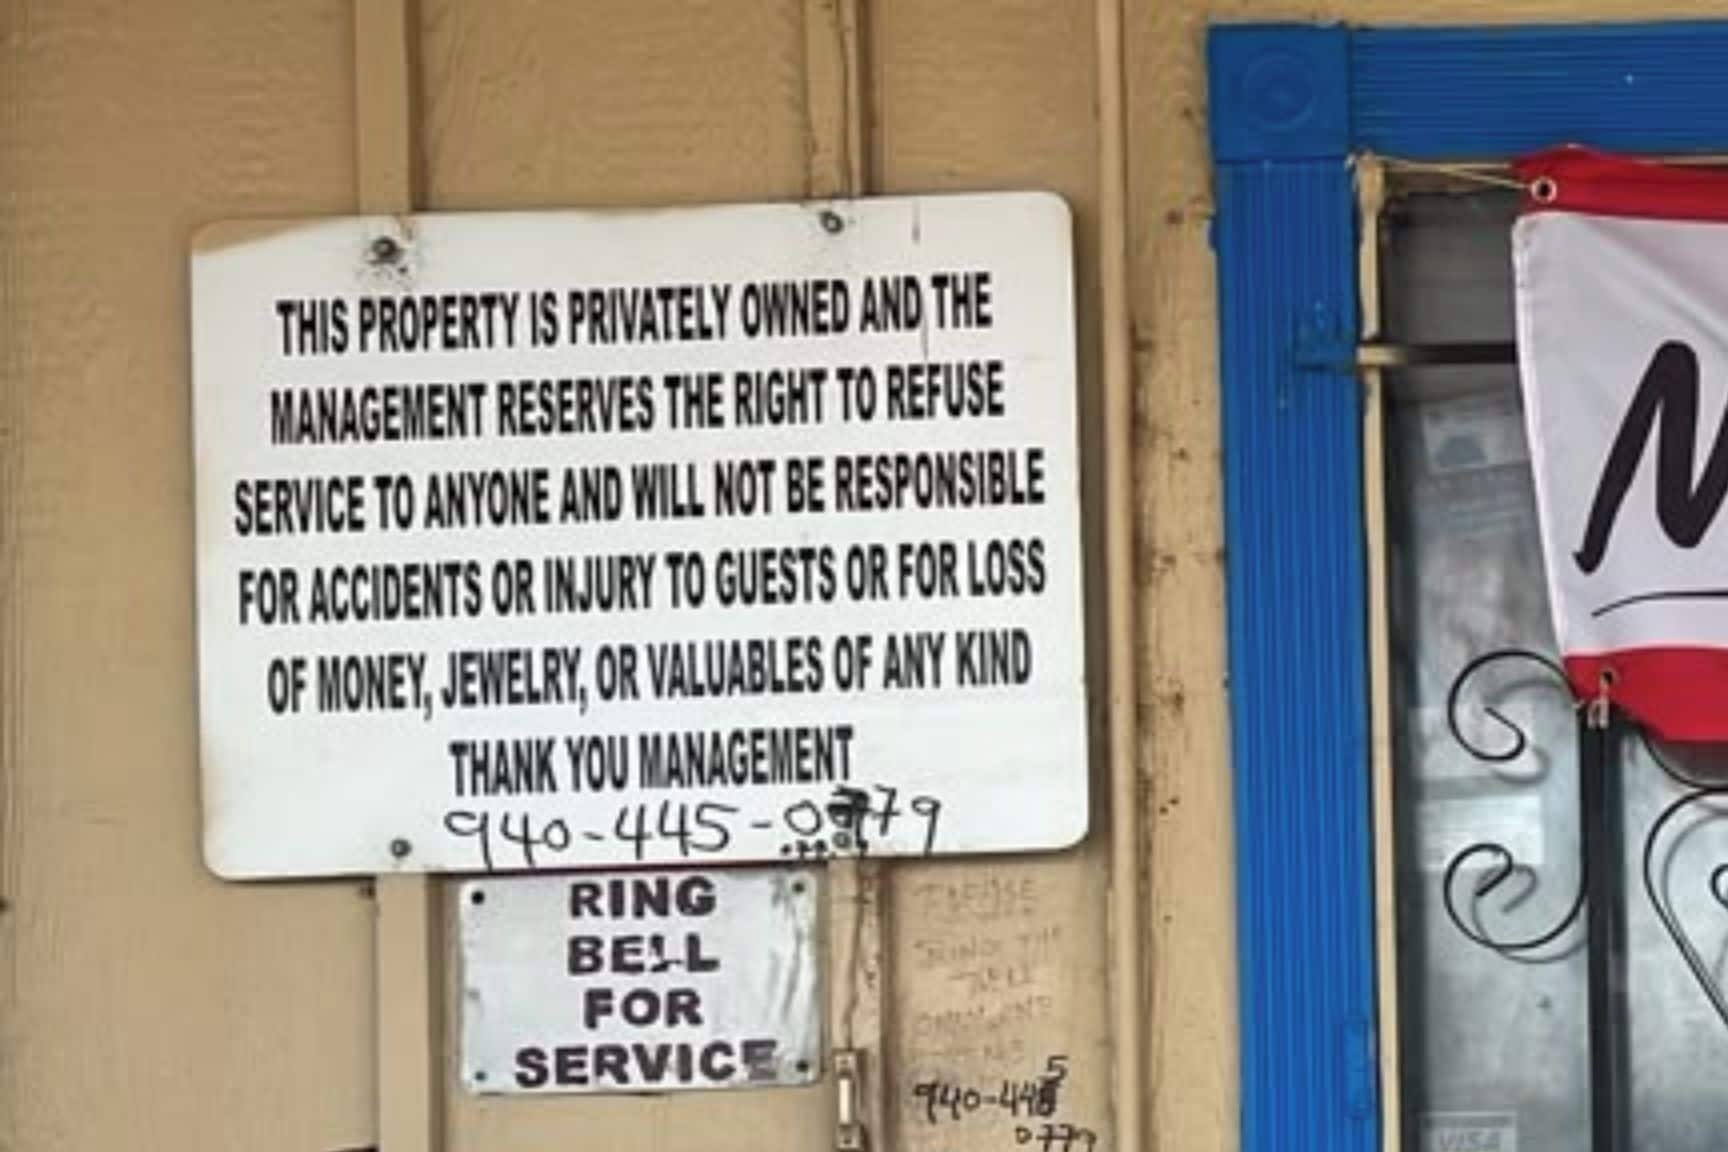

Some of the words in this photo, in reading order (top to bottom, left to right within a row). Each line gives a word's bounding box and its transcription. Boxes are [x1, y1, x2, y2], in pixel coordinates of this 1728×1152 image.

[276, 298, 349, 355] THIS
[359, 292, 520, 353] PROPERTY
[530, 291, 559, 346] IS
[568, 284, 731, 345] PRIVATELY
[741, 279, 850, 338] OWNED
[859, 275, 923, 333] AND
[931, 271, 993, 329] THE
[271, 382, 487, 444] MANAGEMENT
[497, 375, 655, 436] RESERVES
[663, 372, 725, 429] THE
[734, 368, 828, 426] RIGHT
[836, 366, 877, 421] TO
[887, 360, 1005, 420] REFUSE
[235, 476, 365, 537] SERVICE
[374, 474, 414, 530] TO
[424, 468, 550, 528] ANYONE
[559, 466, 622, 523] AND
[631, 463, 705, 519] WILL
[715, 459, 776, 516] NOT
[786, 457, 825, 513] BE
[835, 448, 1045, 511] RESPONSIBLE
[239, 568, 301, 625] FOR
[309, 560, 482, 622] ACCIDENTS
[492, 559, 536, 616] OR
[544, 554, 656, 613] INJURY
[665, 551, 705, 608] TO
[715, 546, 837, 606] GUESTS
[846, 544, 889, 601] OR
[898, 542, 959, 598] FOR
[968, 538, 1046, 596] LOSS
[268, 658, 306, 714] OF
[318, 653, 432, 719] MONEY,
[442, 647, 586, 714] JEWELRY,
[596, 644, 639, 701] OR
[647, 636, 824, 698] VALUABLES
[834, 635, 872, 691] OF
[883, 632, 945, 689] ANY
[956, 629, 1031, 686] KIND
[449, 738, 557, 796] THANK
[566, 735, 629, 792] YOU
[639, 725, 853, 788] MANAGEMENT
[569, 877, 718, 919] RING
[567, 933, 720, 976] BELL
[583, 987, 705, 1030] FOR
[514, 1039, 779, 1089] SERVICE
[1437, 1130, 1502, 1152] VISA
